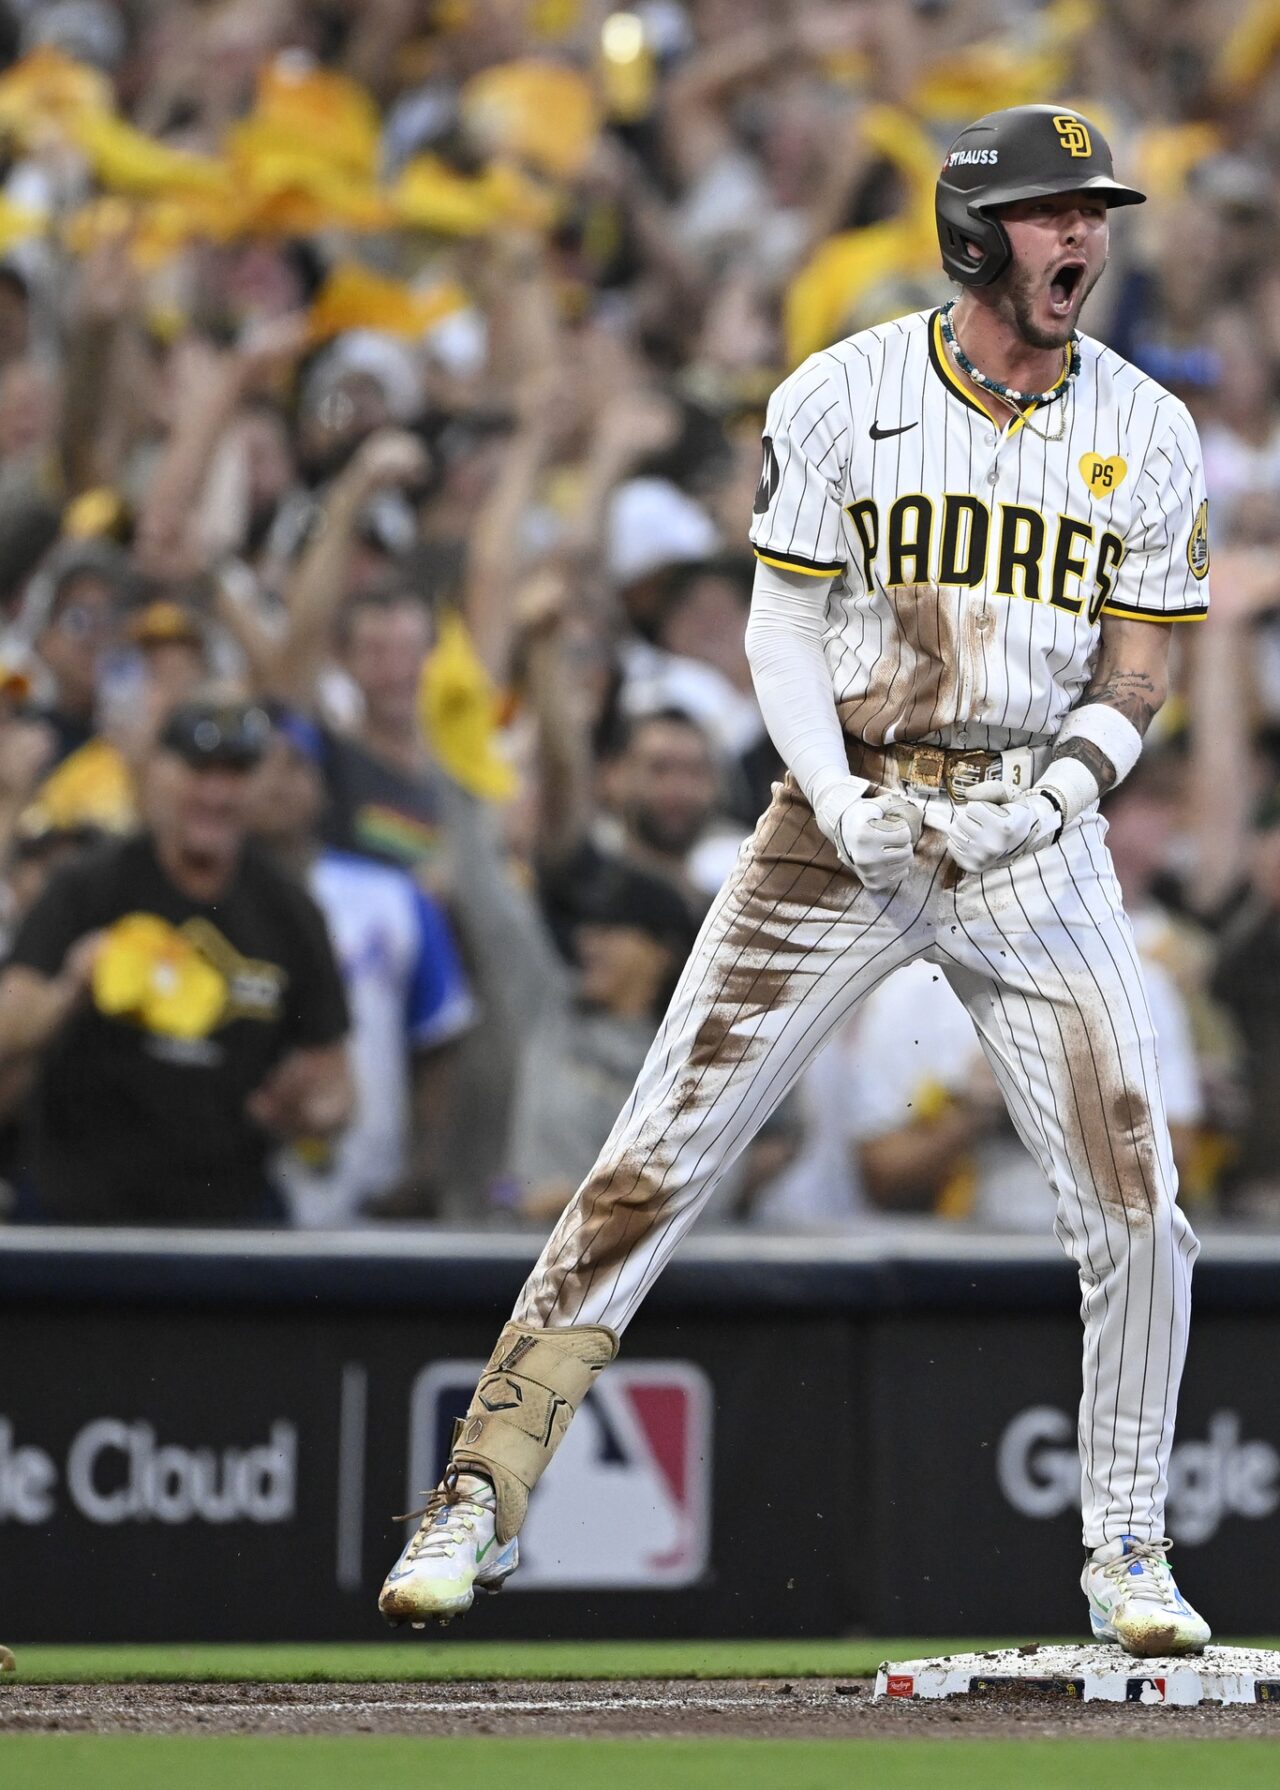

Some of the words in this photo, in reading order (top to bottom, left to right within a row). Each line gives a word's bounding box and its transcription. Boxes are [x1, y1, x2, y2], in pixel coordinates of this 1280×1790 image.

[1053, 116, 1092, 157] SD
[949, 149, 998, 167] STRAUSS
[1091, 462, 1114, 488] PS
[845, 491, 1124, 628] PADRES
[1012, 765, 1021, 786] 3
[66, 1414, 298, 1525] Cloud
[998, 1405, 1280, 1546] Ggle
